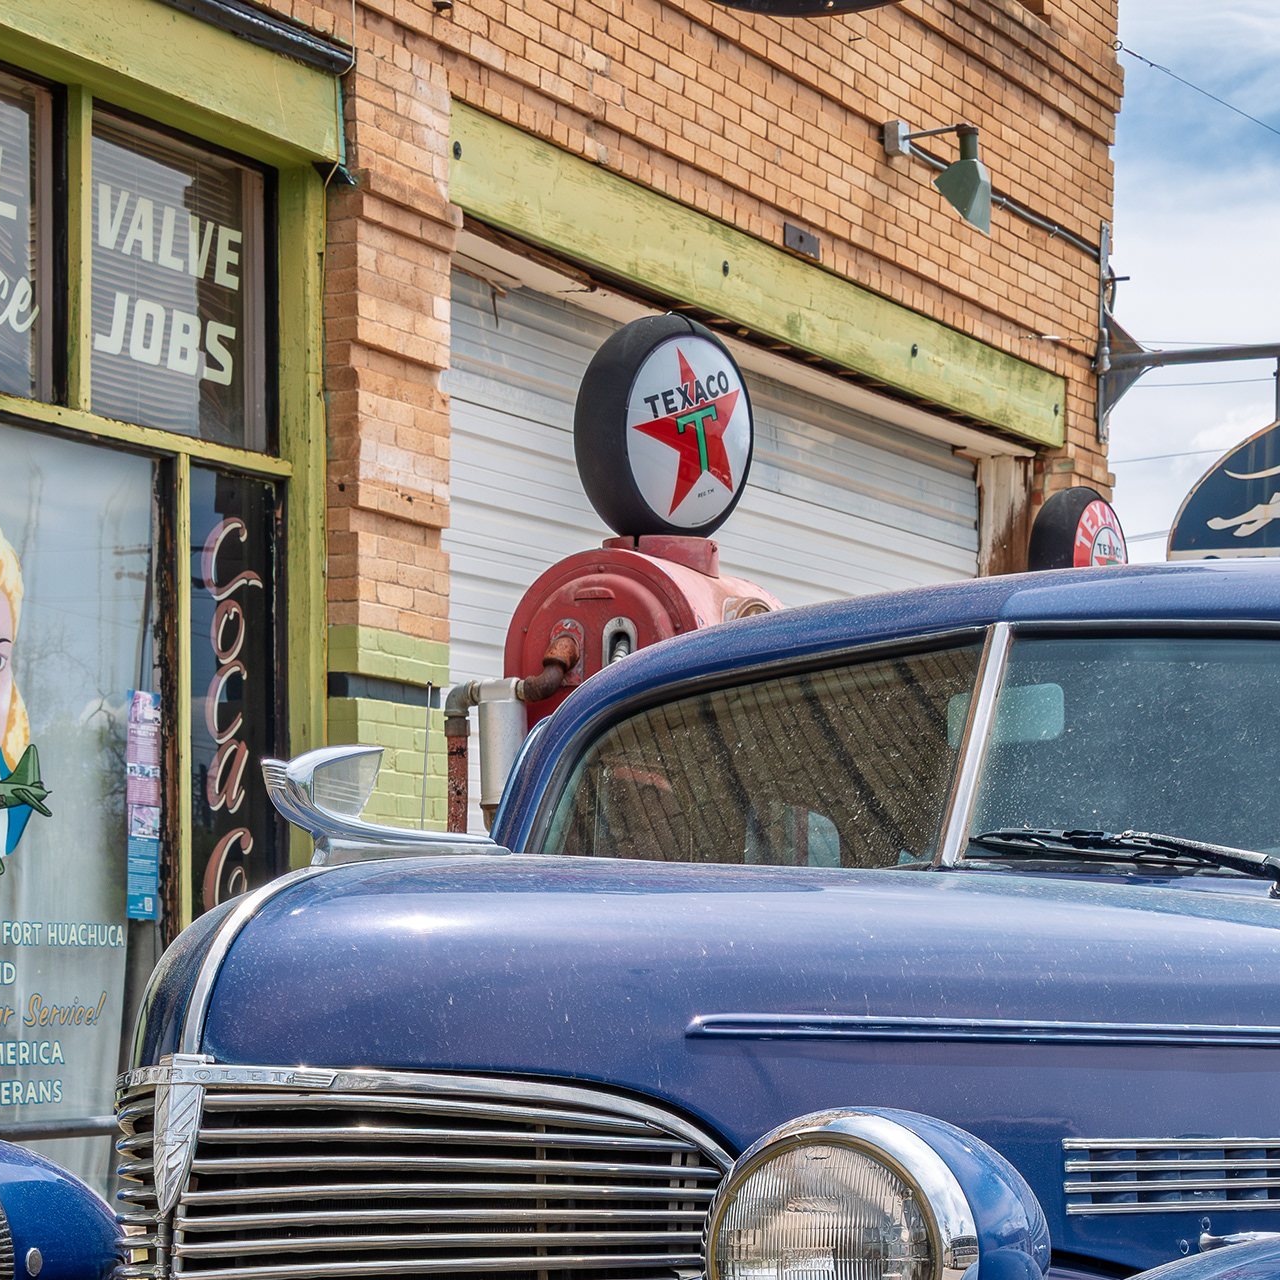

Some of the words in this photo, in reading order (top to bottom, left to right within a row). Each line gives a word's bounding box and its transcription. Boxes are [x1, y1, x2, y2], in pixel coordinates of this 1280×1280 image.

[98, 183, 242, 292] VALVE
[94, 292, 236, 386] JOBS
[644, 371, 729, 419] TEXACO
[2, 920, 43, 947] FORT
[47, 922, 125, 948] HUACHUCA
[23, 991, 107, 1027] Service!
[124, 1068, 286, 1085] CHEVROLET
